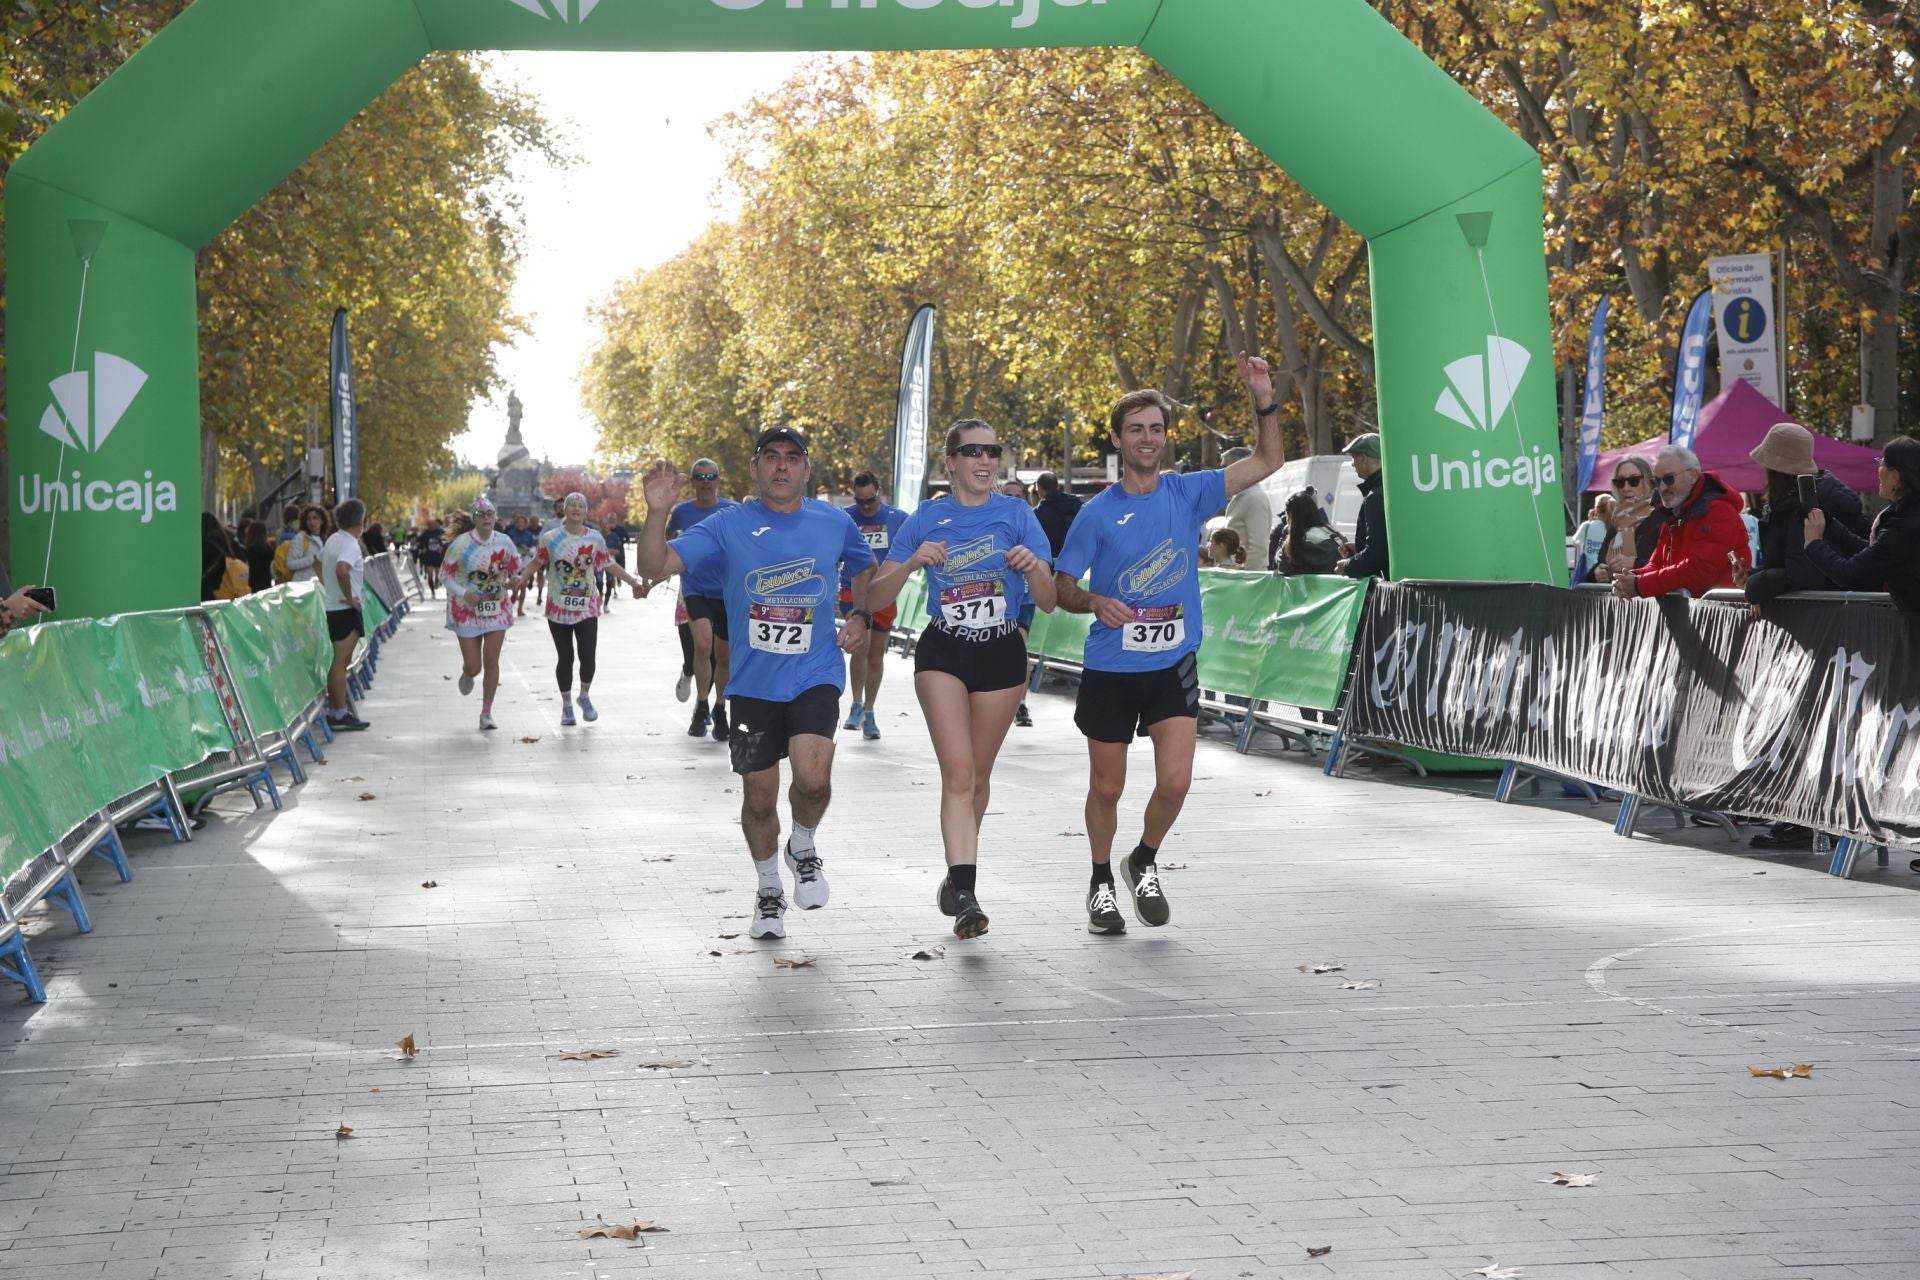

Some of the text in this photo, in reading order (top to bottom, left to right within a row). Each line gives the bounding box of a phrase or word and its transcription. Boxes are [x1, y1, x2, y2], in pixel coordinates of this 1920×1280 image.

[1716, 263, 1754, 274] Oficina de
[1678, 334, 1704, 449] VECO
[904, 365, 925, 481] Unicaja
[1411, 445, 1556, 496] Unicaja
[19, 470, 177, 523] Unicaja
[477, 601, 496, 613] 863
[564, 596, 586, 608] 864
[951, 599, 995, 620] 371
[757, 622, 802, 645] 372
[931, 616, 953, 634] IKE
[955, 625, 991, 642] PRO
[1133, 623, 1175, 643] 370
